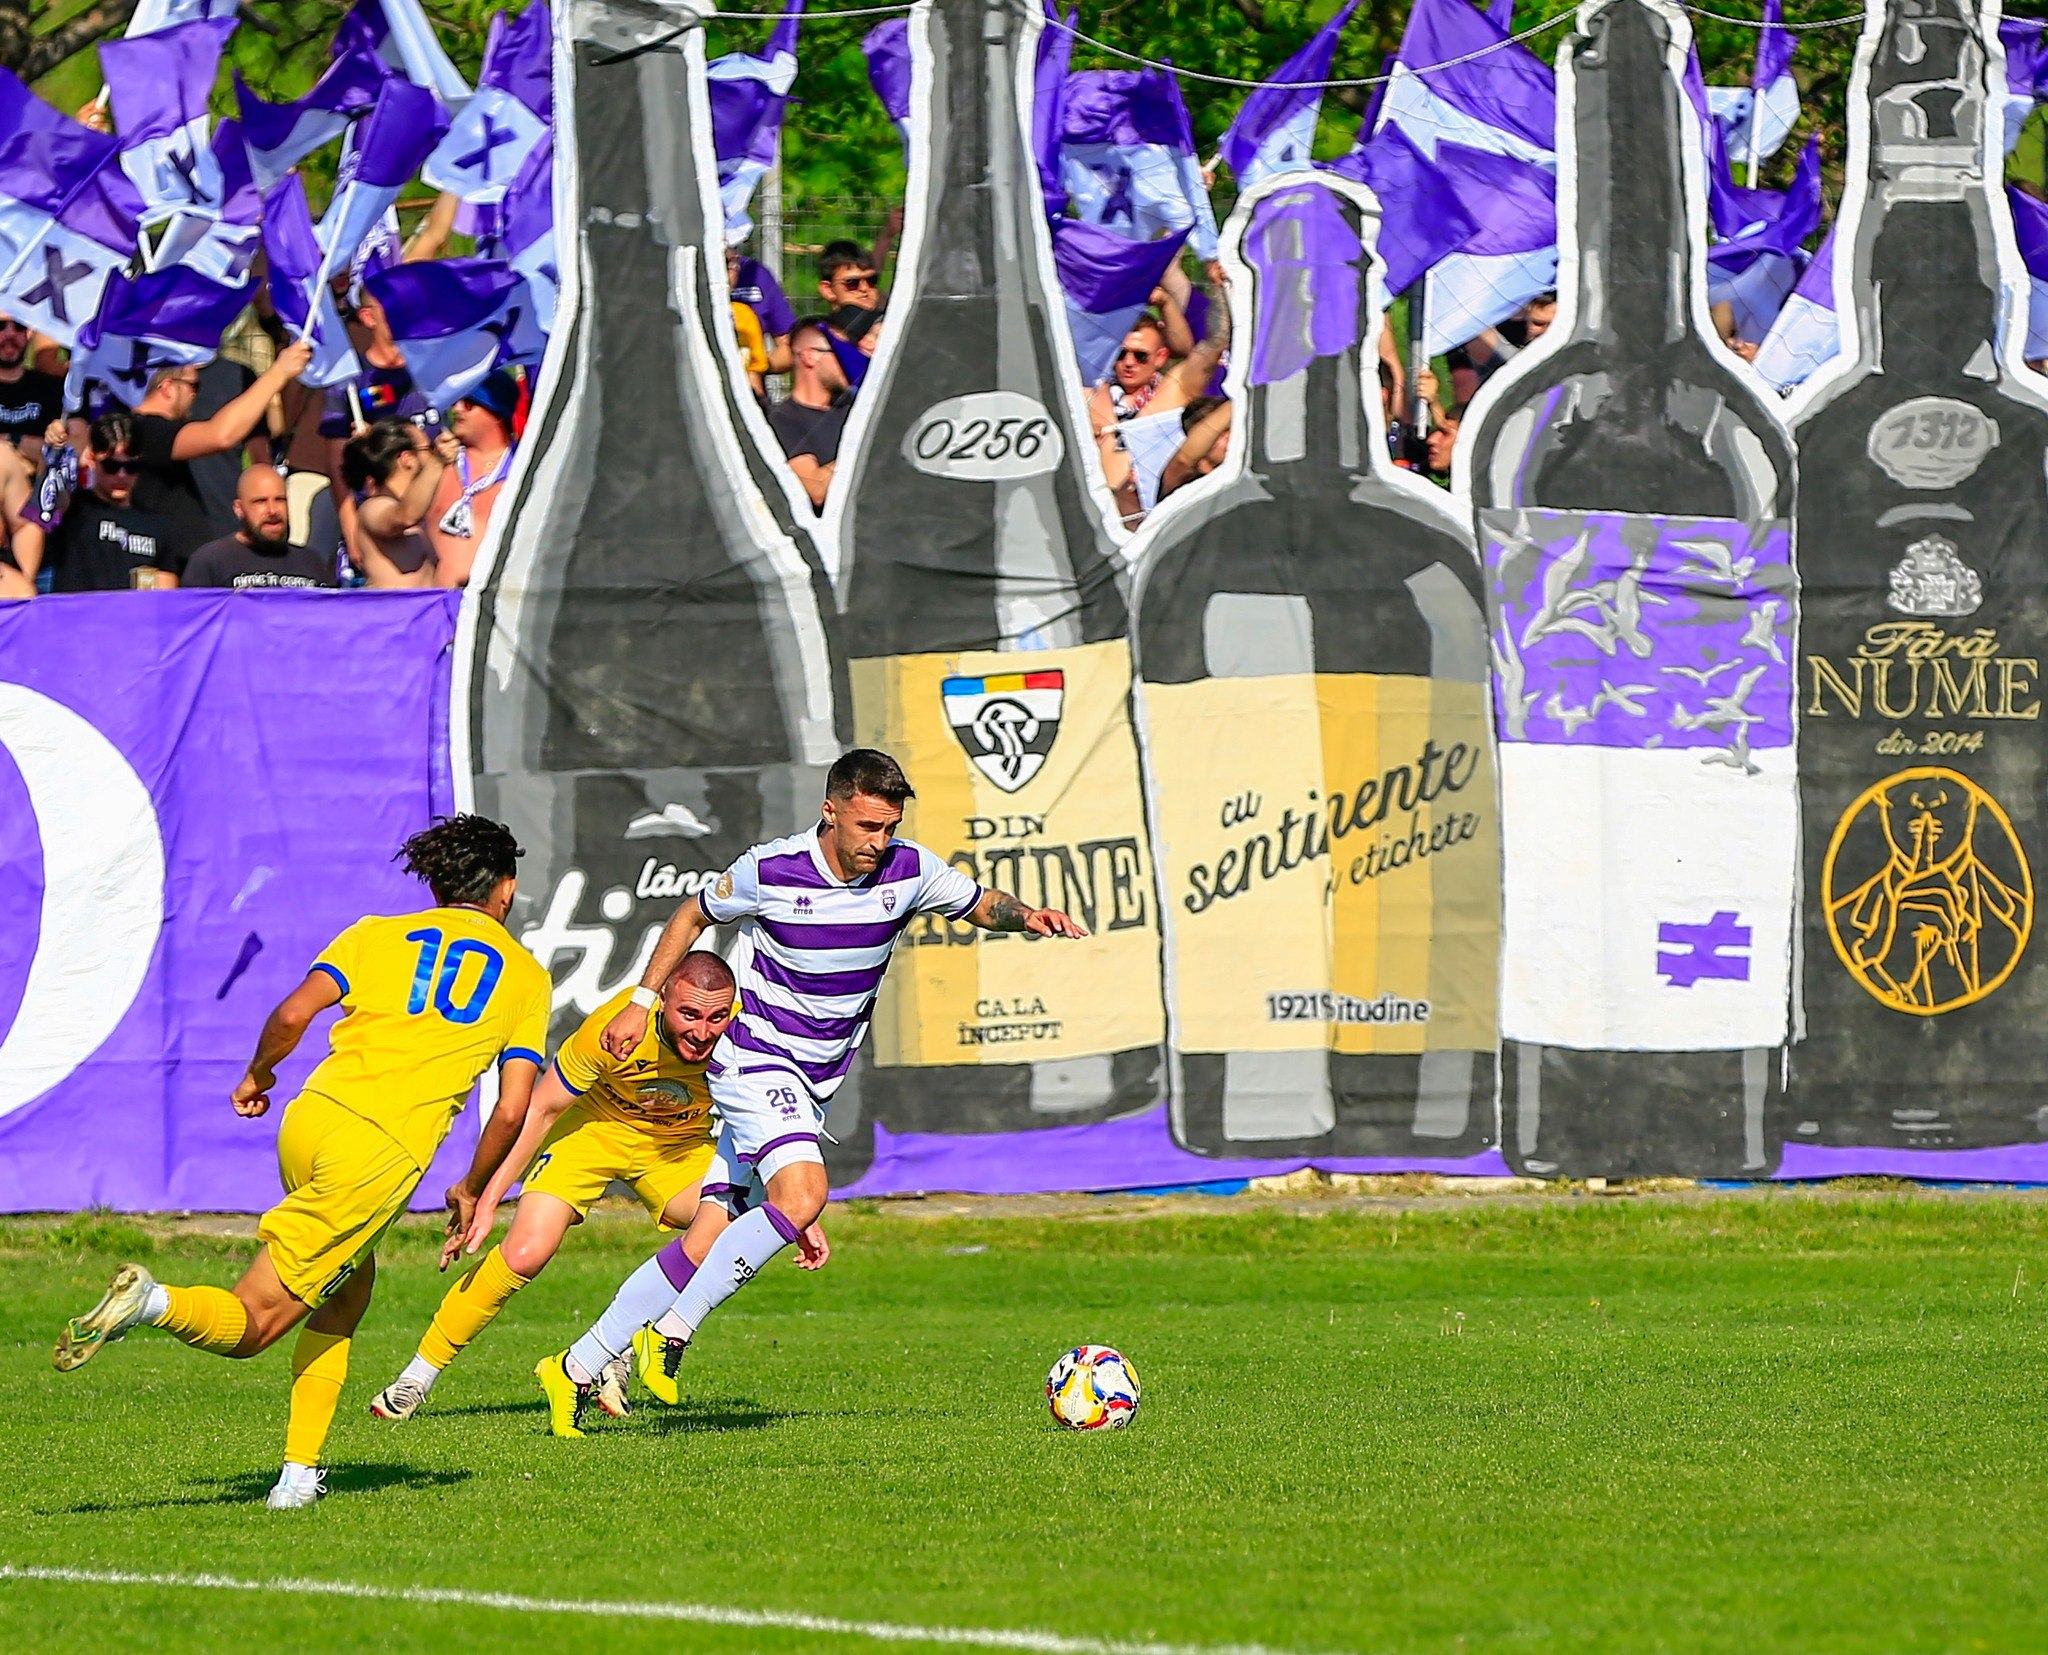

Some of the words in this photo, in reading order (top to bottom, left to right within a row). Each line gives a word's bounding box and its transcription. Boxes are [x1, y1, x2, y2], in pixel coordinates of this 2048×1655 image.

[916, 418, 1049, 460] 0256
[1887, 410, 1980, 449] 1312
[1806, 654, 2042, 721] NUME
[1875, 728, 1918, 755] din
[1920, 730, 1985, 755] 2014
[964, 814, 1046, 840] DIN
[1222, 790, 1263, 828] cu
[1351, 808, 1482, 885] etichete
[405, 927, 504, 1024] 10
[765, 1086, 798, 1108] 26
